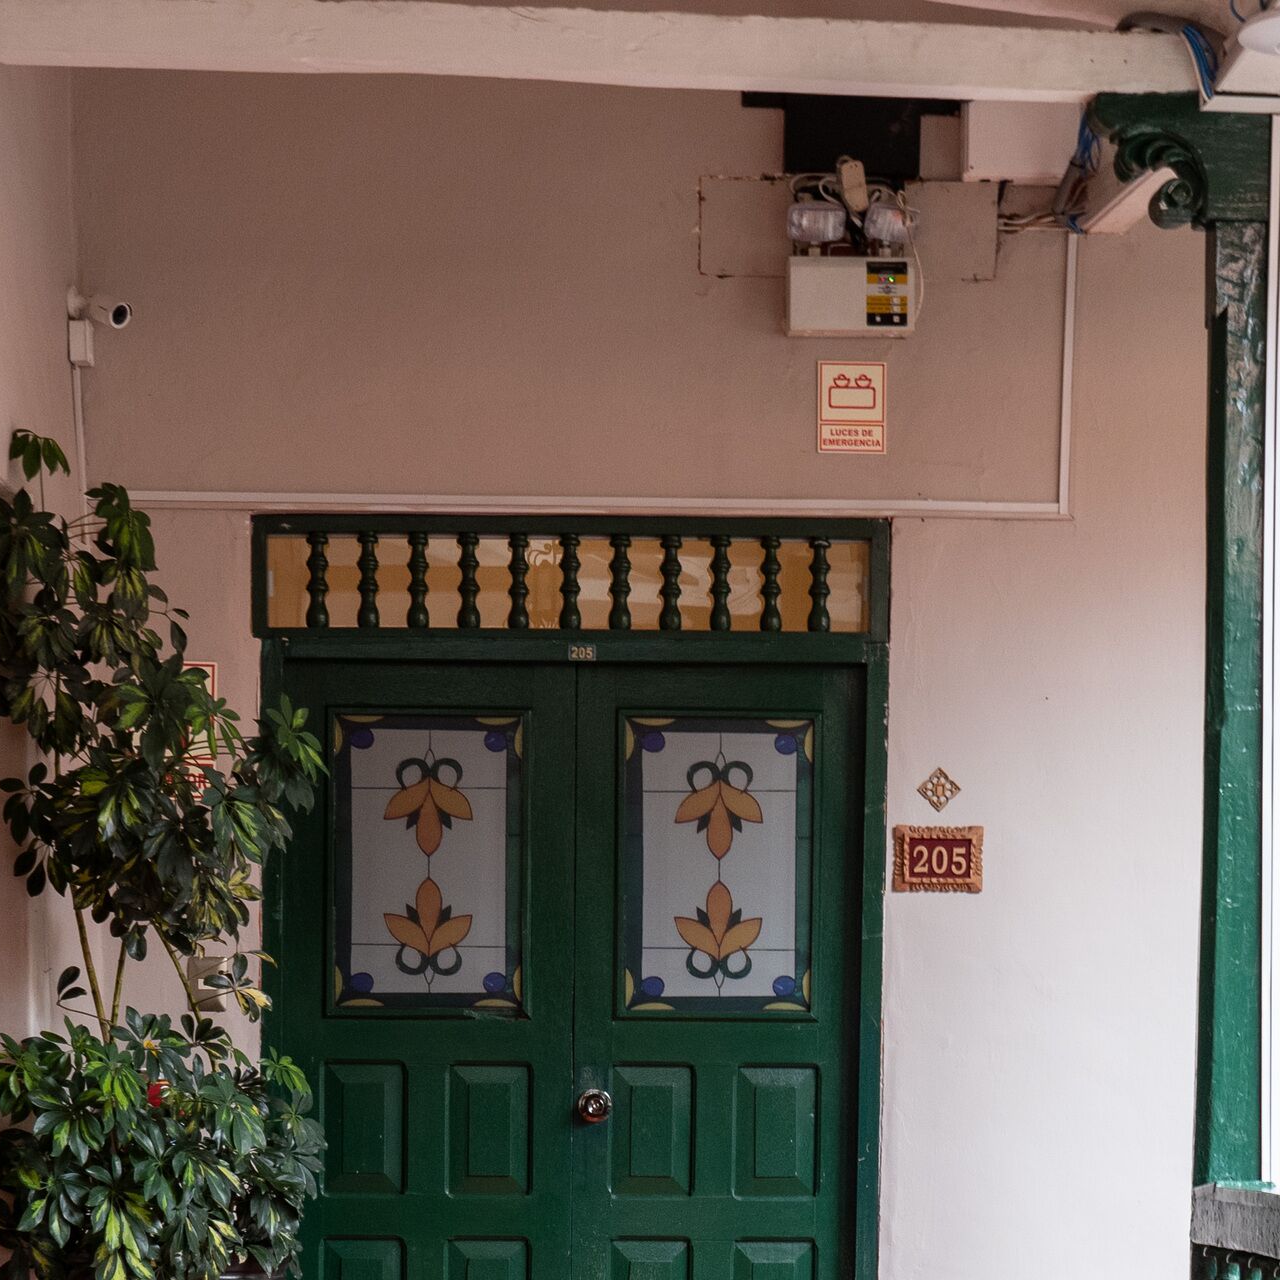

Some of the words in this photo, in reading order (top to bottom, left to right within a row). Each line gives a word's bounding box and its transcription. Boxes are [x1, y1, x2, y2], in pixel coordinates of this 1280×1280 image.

[830, 428, 859, 437] LUCES
[861, 428, 874, 437] DE
[822, 438, 881, 447] EMERGENCIA
[571, 646, 593, 659] 205
[913, 845, 967, 875] 205
